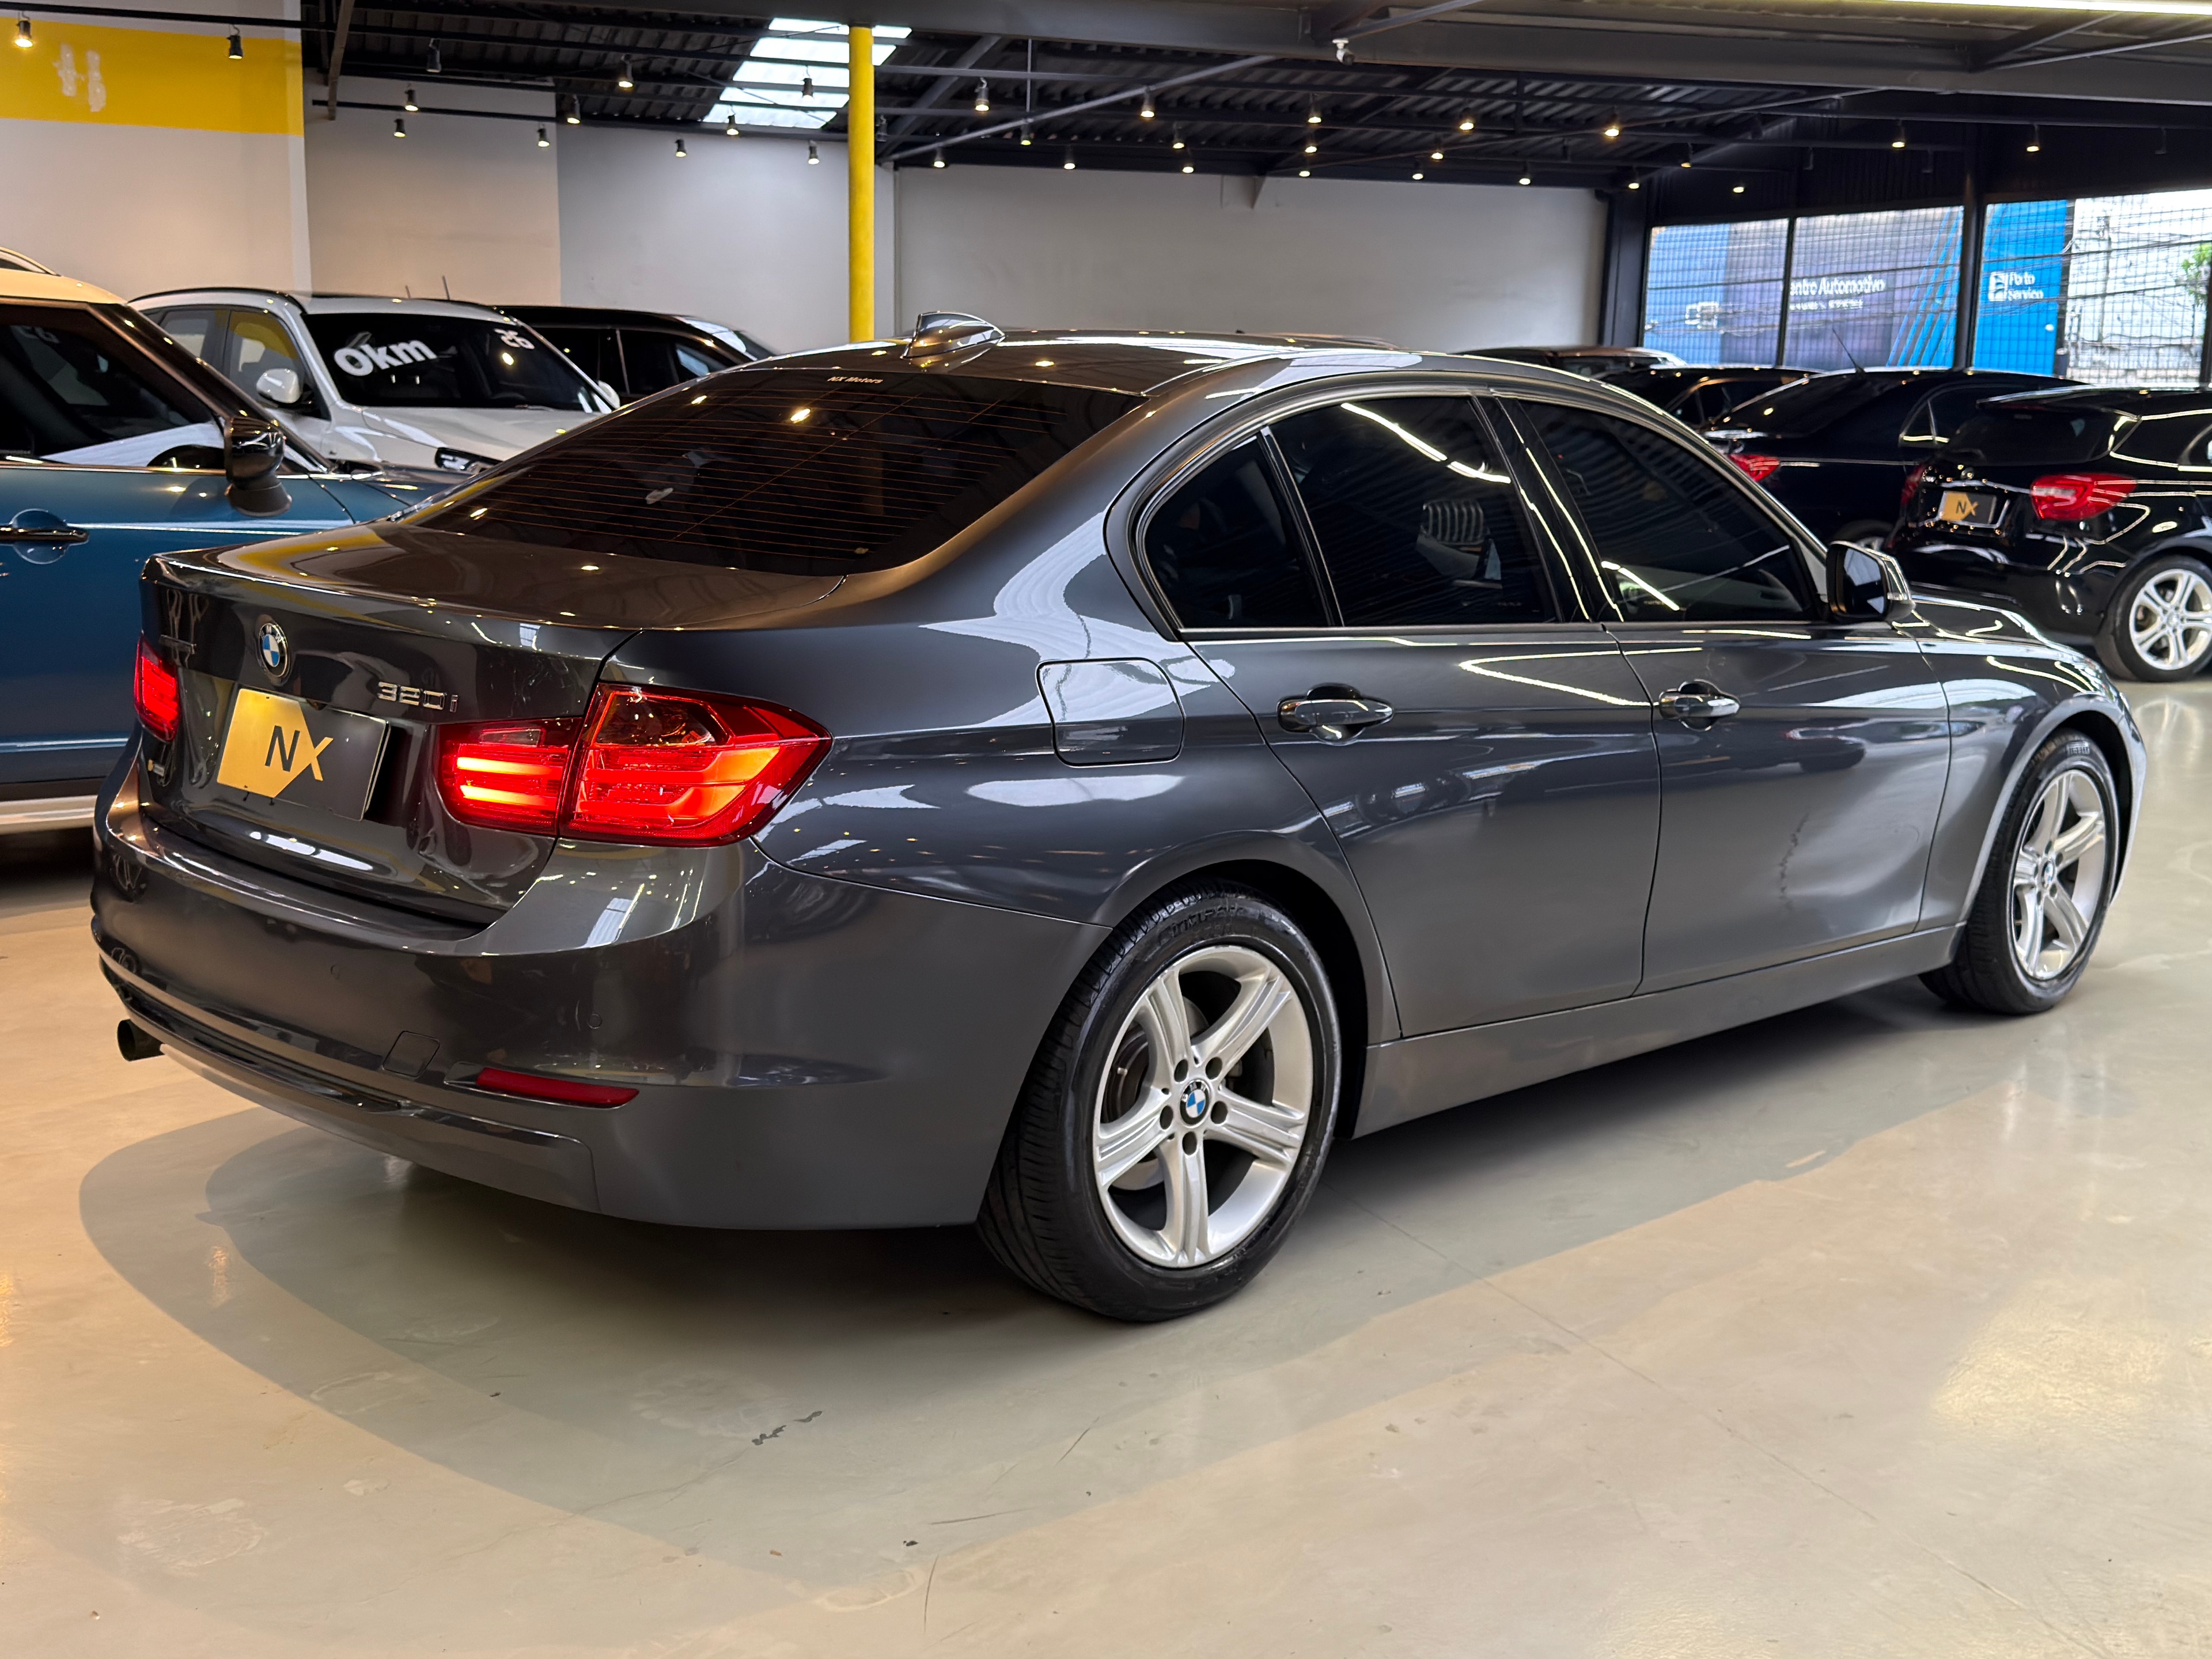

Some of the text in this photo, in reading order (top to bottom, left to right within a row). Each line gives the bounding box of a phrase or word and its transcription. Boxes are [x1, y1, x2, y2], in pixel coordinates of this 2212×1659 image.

[1790, 278, 1818, 296] entro
[1956, 501, 1979, 516] NX
[378, 681, 459, 713] 320i
[264, 725, 334, 782] NX
